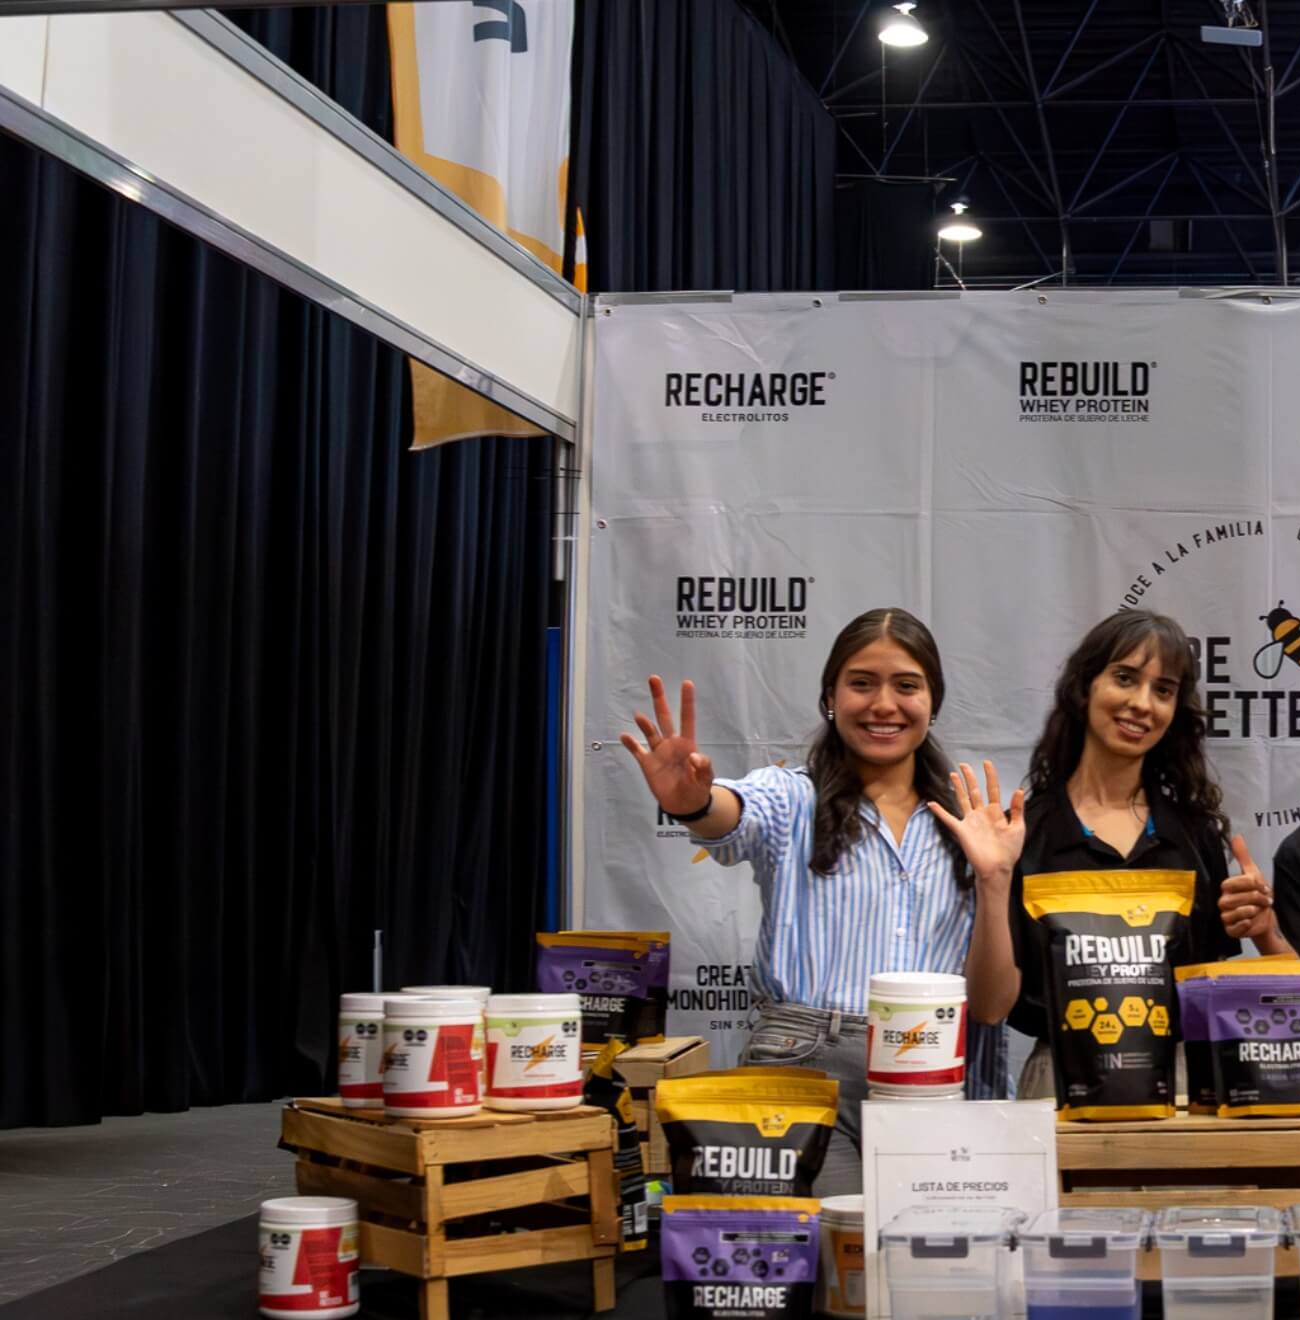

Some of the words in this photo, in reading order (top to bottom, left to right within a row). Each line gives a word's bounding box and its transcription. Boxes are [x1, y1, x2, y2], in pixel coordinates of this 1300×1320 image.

[1020, 400, 1070, 413] WHEY
[1076, 400, 1149, 413] PROTEIN
[702, 412, 789, 422] ELECTROLITOS
[1152, 562, 1165, 575] A
[1165, 543, 1189, 563] LA
[1193, 520, 1263, 548] FAMILIA
[677, 616, 727, 628] WHEY
[733, 616, 806, 629] PROTEIN
[1066, 934, 1166, 966] REBUILD
[710, 1021, 733, 1030] SIN
[884, 1029, 941, 1045] RECHARGE
[691, 1146, 797, 1180] REBUILD
[912, 1182, 944, 1192] LISTA
[946, 1182, 960, 1192] DE
[962, 1182, 1009, 1192] PRECIOS
[694, 1286, 786, 1308] RECHARGE
